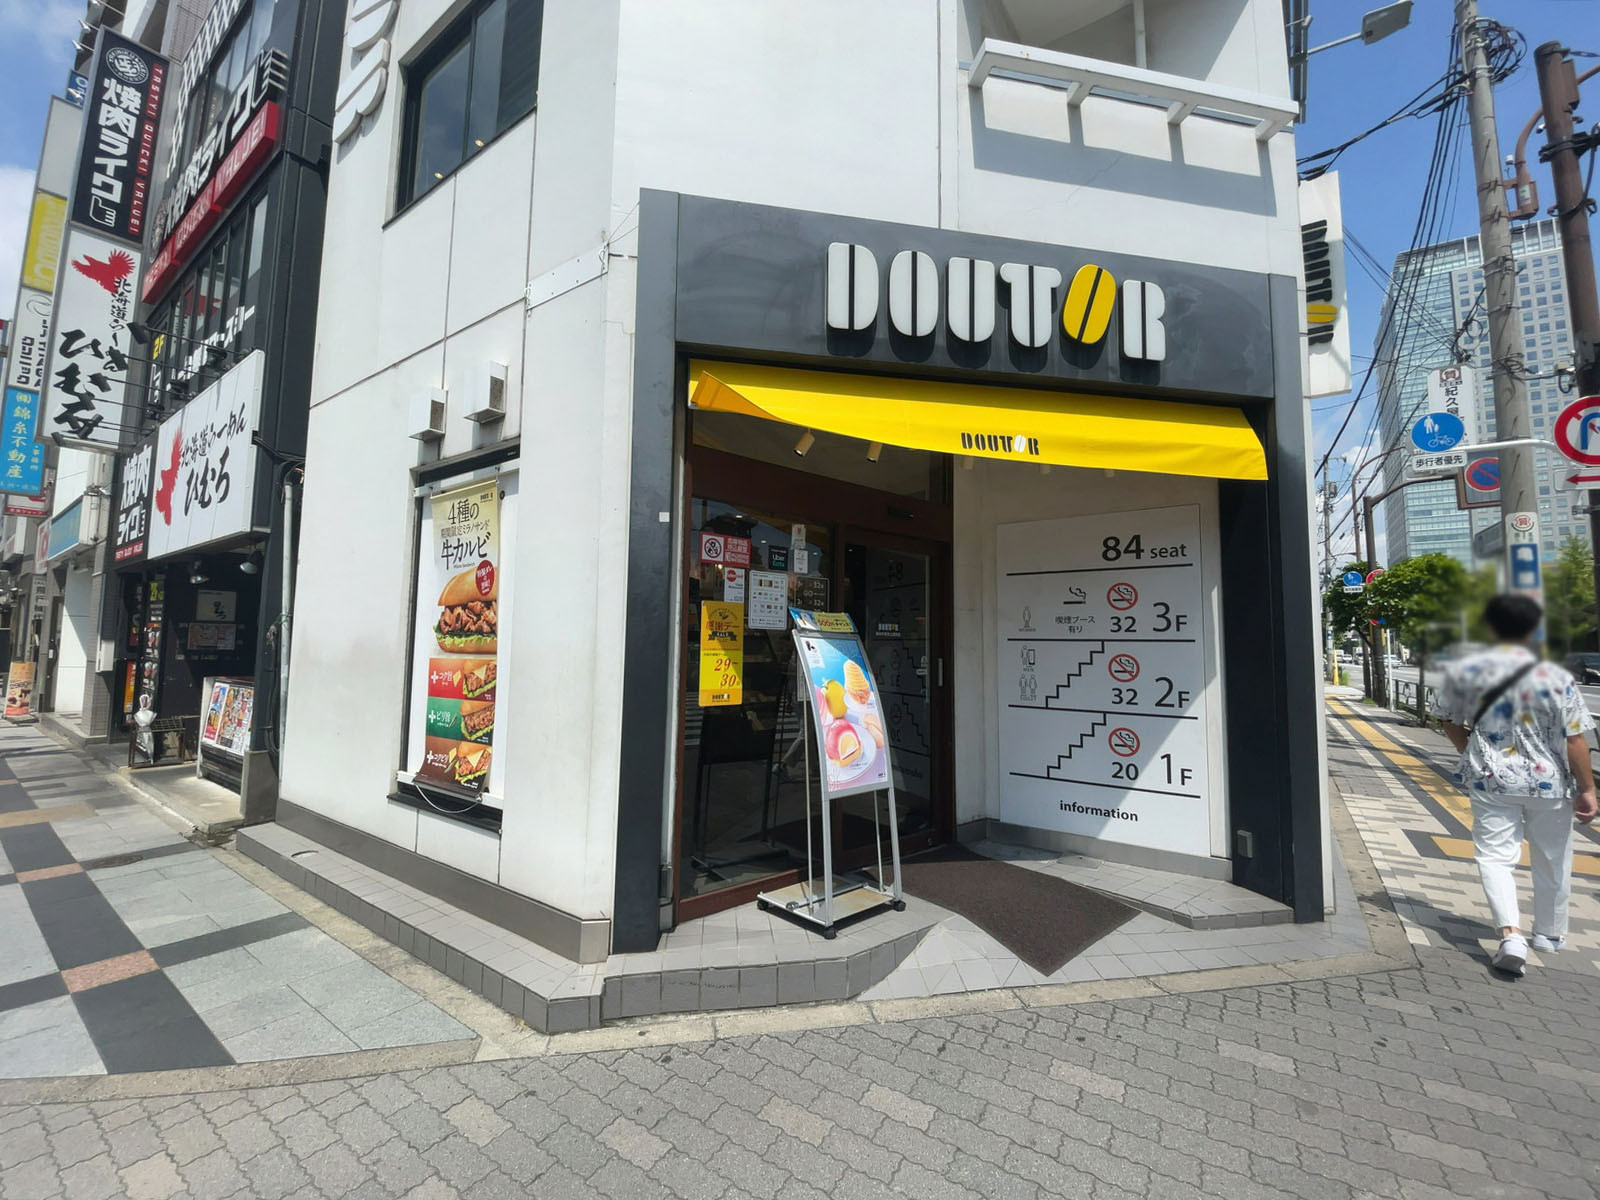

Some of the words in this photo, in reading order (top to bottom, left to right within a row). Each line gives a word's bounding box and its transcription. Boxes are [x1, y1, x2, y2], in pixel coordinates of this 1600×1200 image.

[92, 77, 142, 204] 焼肉ライク
[129, 181, 145, 233] VALUE!
[827, 241, 1166, 362] DOUTOR
[104, 278, 133, 374] 北海道らーん
[961, 432, 1040, 456] DOUTOR
[1415, 455, 1464, 468] 歩行者優先
[184, 446, 231, 517] ひむろ
[447, 499, 480, 525] 4種の
[441, 531, 492, 570] 牛カルビ
[1102, 534, 1144, 562] 84
[1150, 543, 1187, 559] seat
[1055, 616, 1096, 624] 喫煙ブース
[1110, 616, 1137, 633] 32
[1152, 601, 1187, 632] 3F
[1111, 688, 1138, 705] 32
[1154, 676, 1190, 709] 2F
[1111, 762, 1139, 781] 20
[1160, 753, 1192, 786] 1F
[1059, 800, 1139, 822] information
